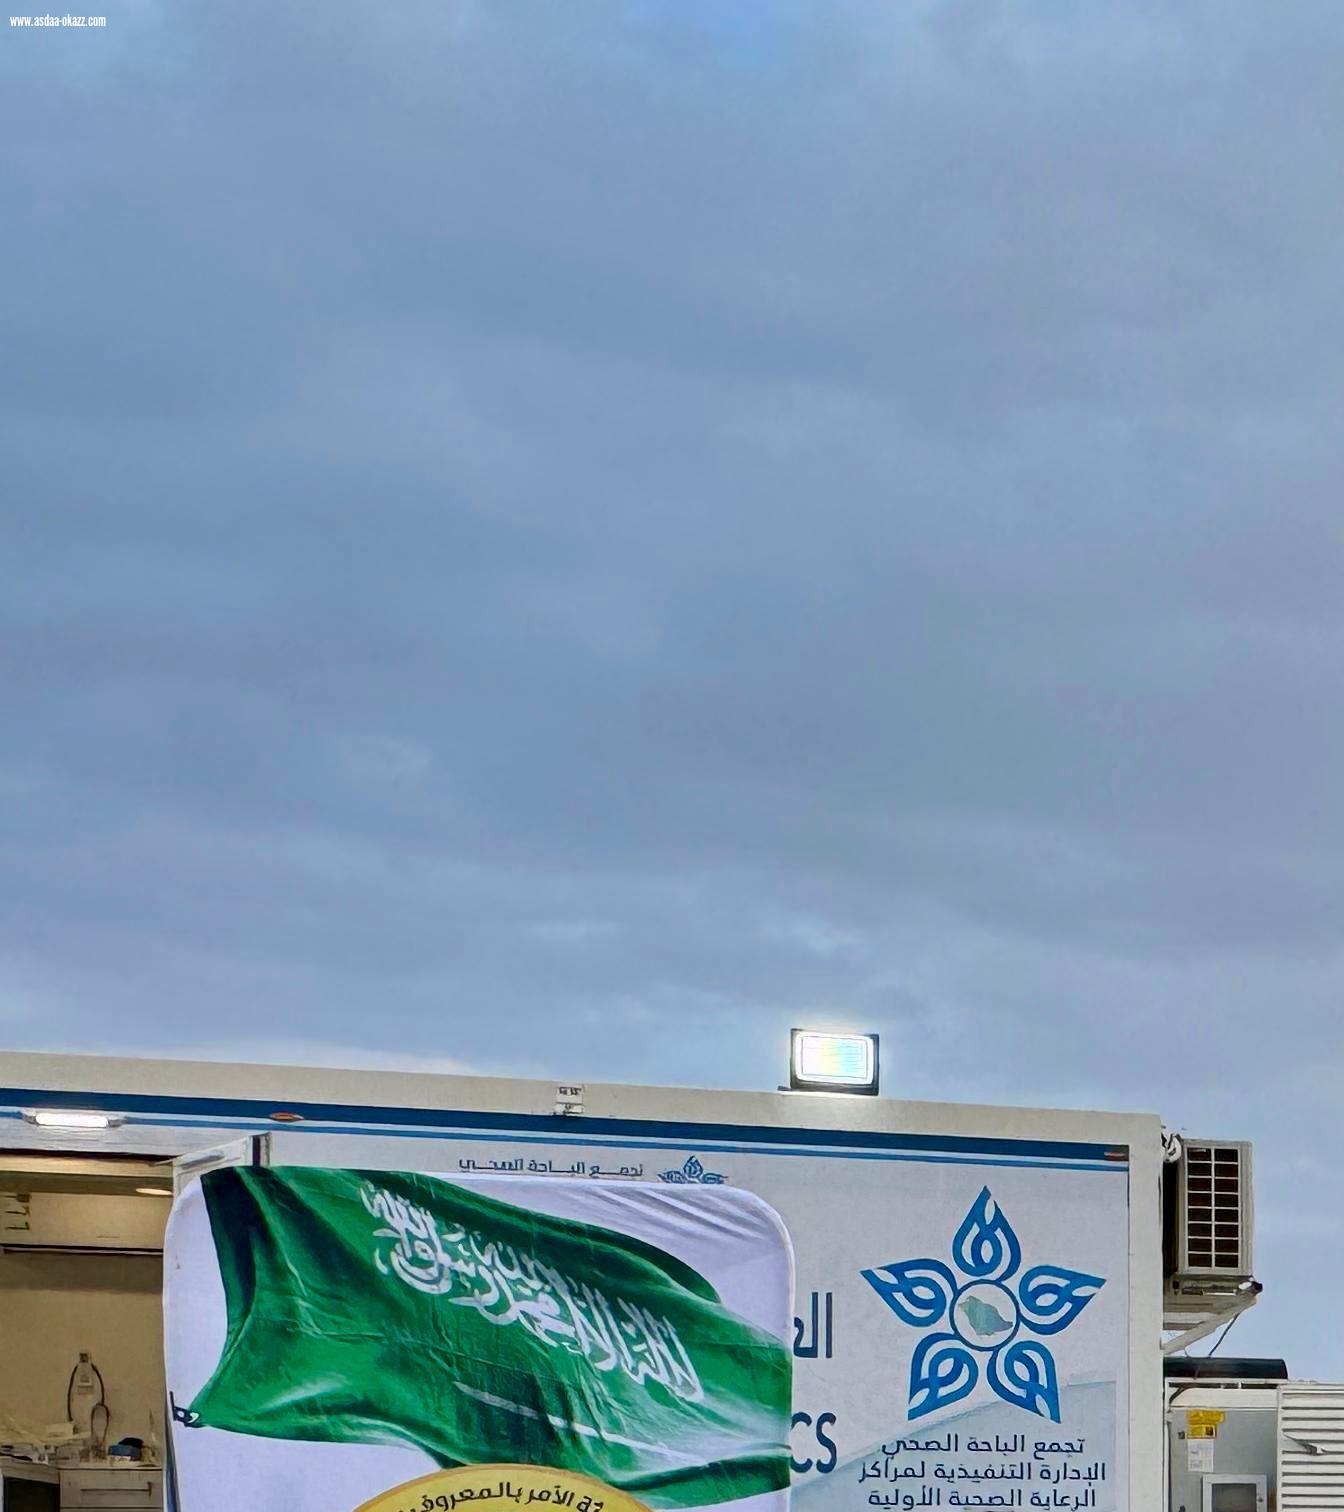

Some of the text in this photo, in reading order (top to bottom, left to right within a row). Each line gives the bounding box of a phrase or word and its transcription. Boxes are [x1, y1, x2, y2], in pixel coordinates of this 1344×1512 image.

[881, 1433, 1086, 1460] تجمع الباحة الصحي
